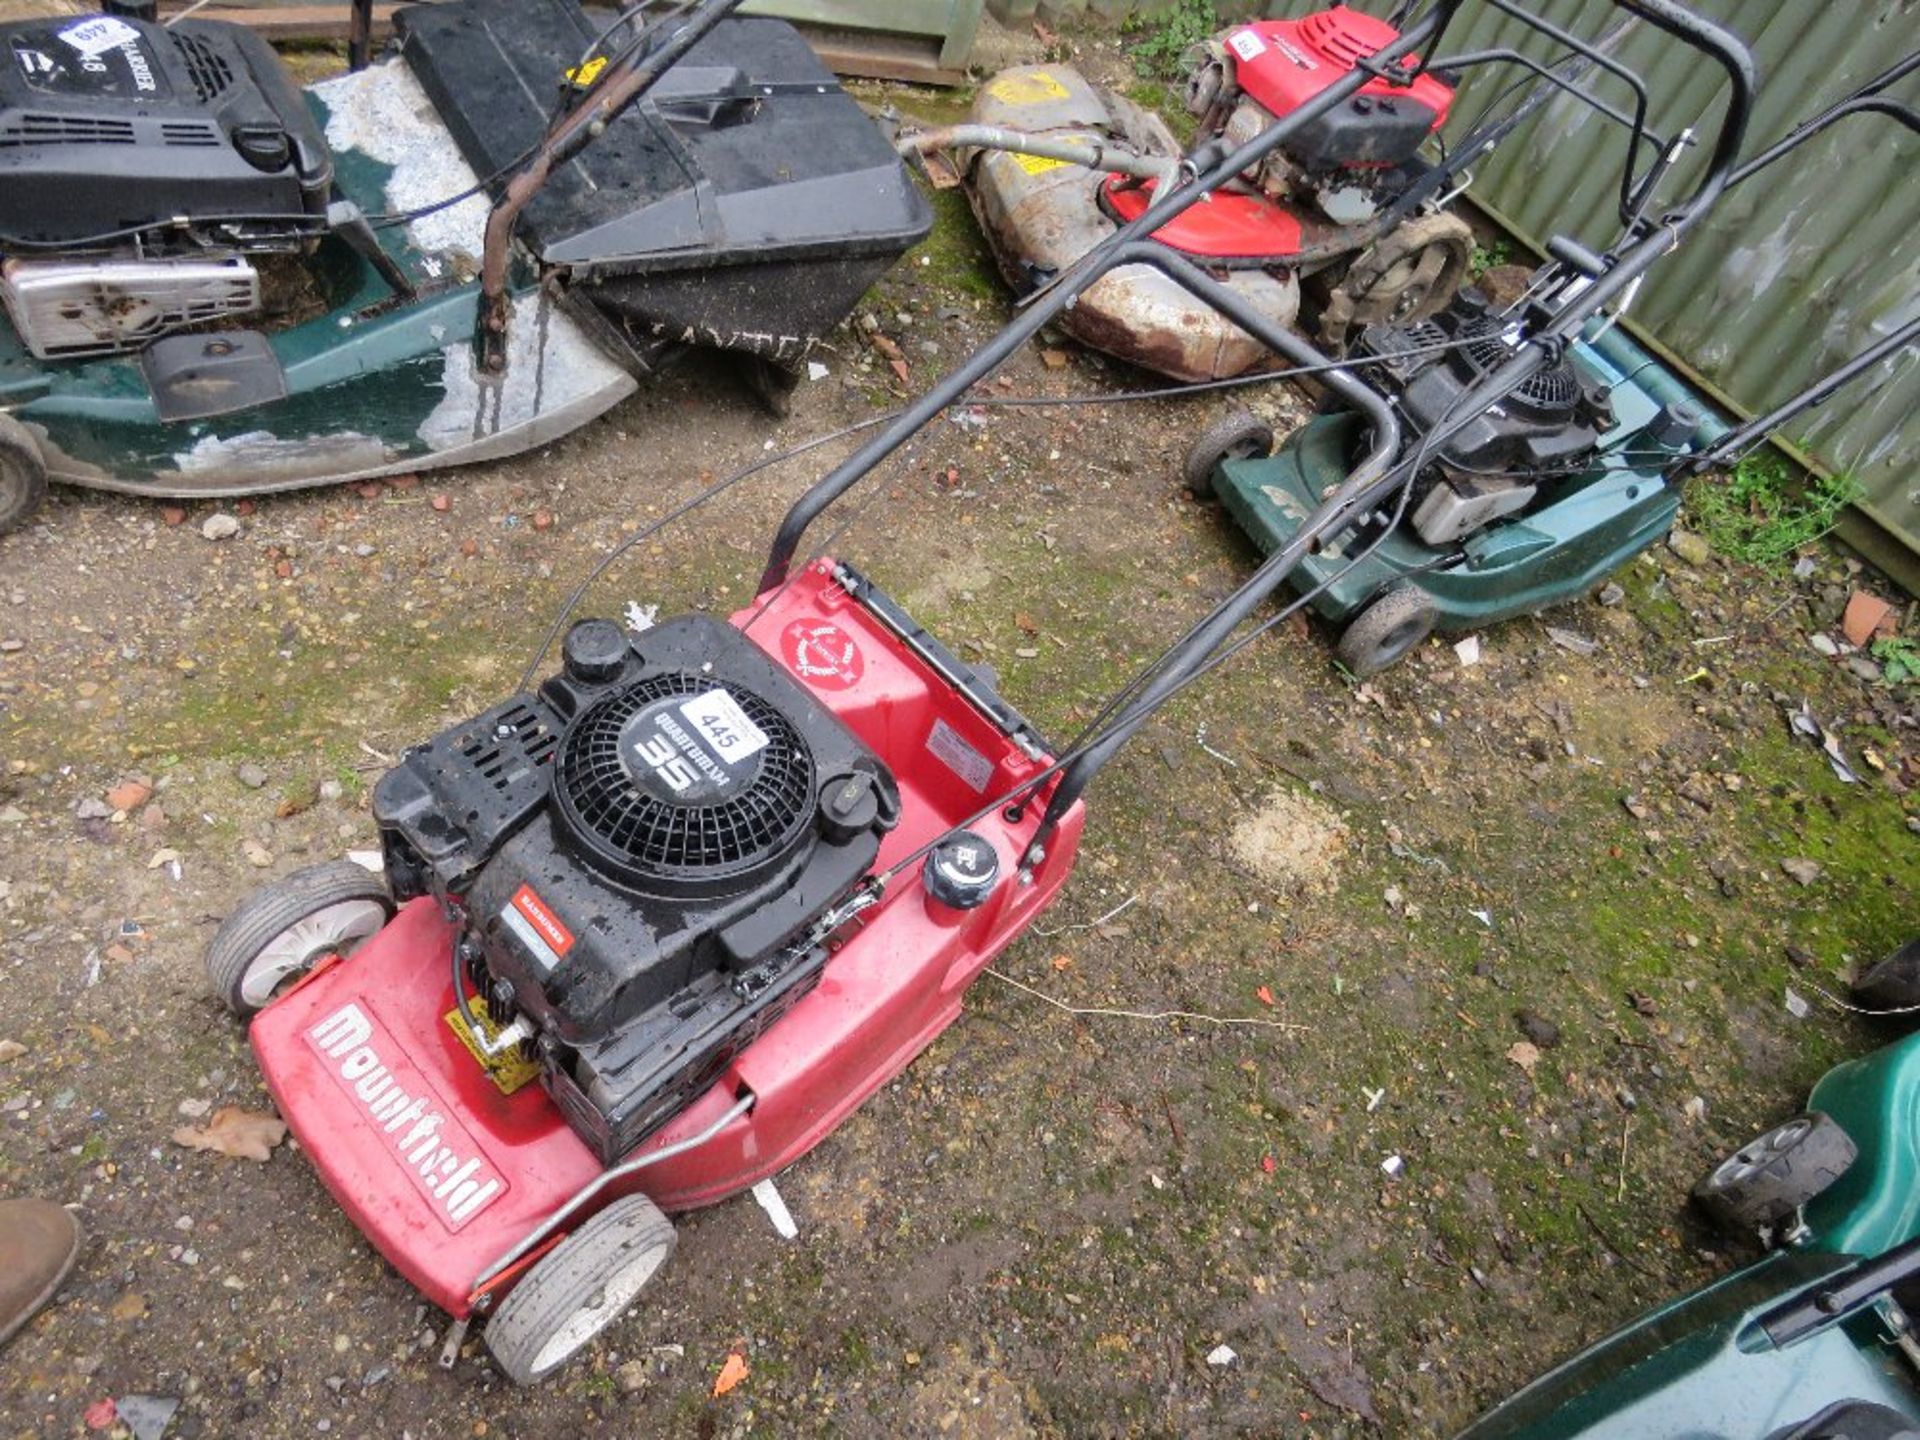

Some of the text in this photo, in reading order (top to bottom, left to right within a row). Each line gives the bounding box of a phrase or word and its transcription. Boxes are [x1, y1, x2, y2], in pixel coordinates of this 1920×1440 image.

[654, 711, 715, 771] QUANTUM
[702, 715, 739, 748] 445
[634, 733, 701, 791] 35
